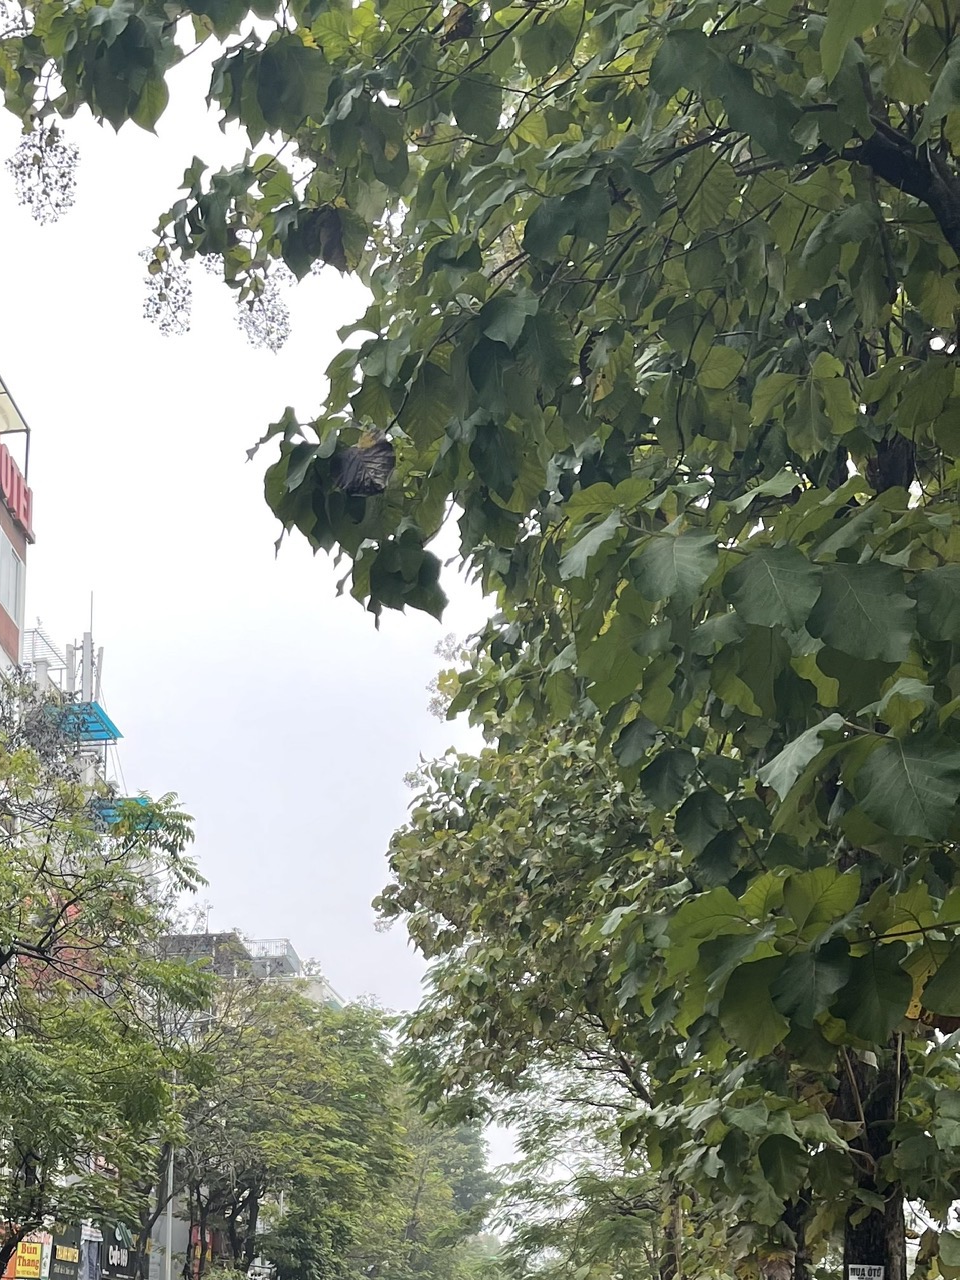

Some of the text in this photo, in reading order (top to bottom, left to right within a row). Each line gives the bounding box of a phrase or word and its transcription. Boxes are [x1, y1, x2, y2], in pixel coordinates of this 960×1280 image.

[21, 1242, 37, 1255] Bún
[17, 1256, 39, 1270] Thang
[850, 1266, 882, 1277] MUA ÔTÔ
